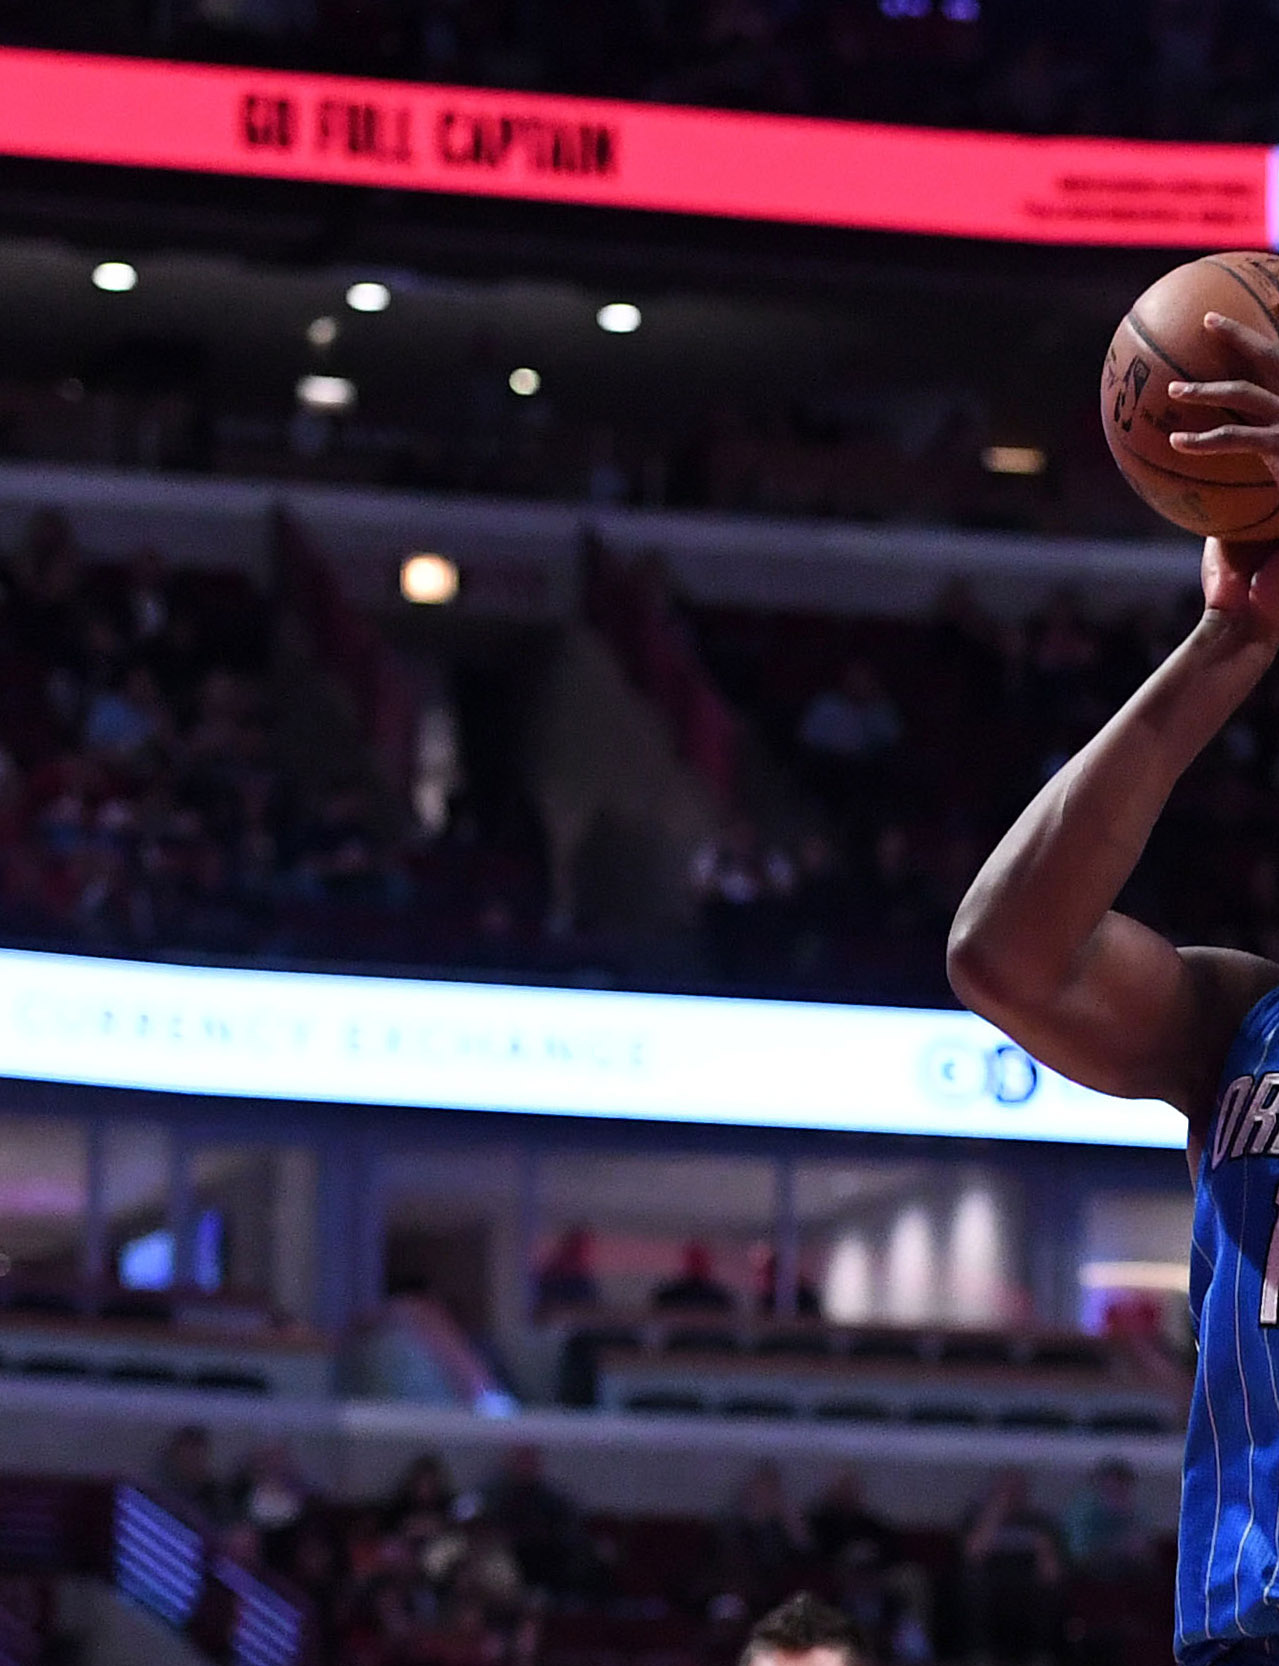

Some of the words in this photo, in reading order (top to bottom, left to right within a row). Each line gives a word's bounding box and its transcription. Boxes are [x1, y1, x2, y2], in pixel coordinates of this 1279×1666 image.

[242, 95, 290, 148] GO
[315, 101, 411, 165] FULL
[438, 111, 617, 175] CAPTAIN
[338, 1012, 657, 1082] EXCHANGE
